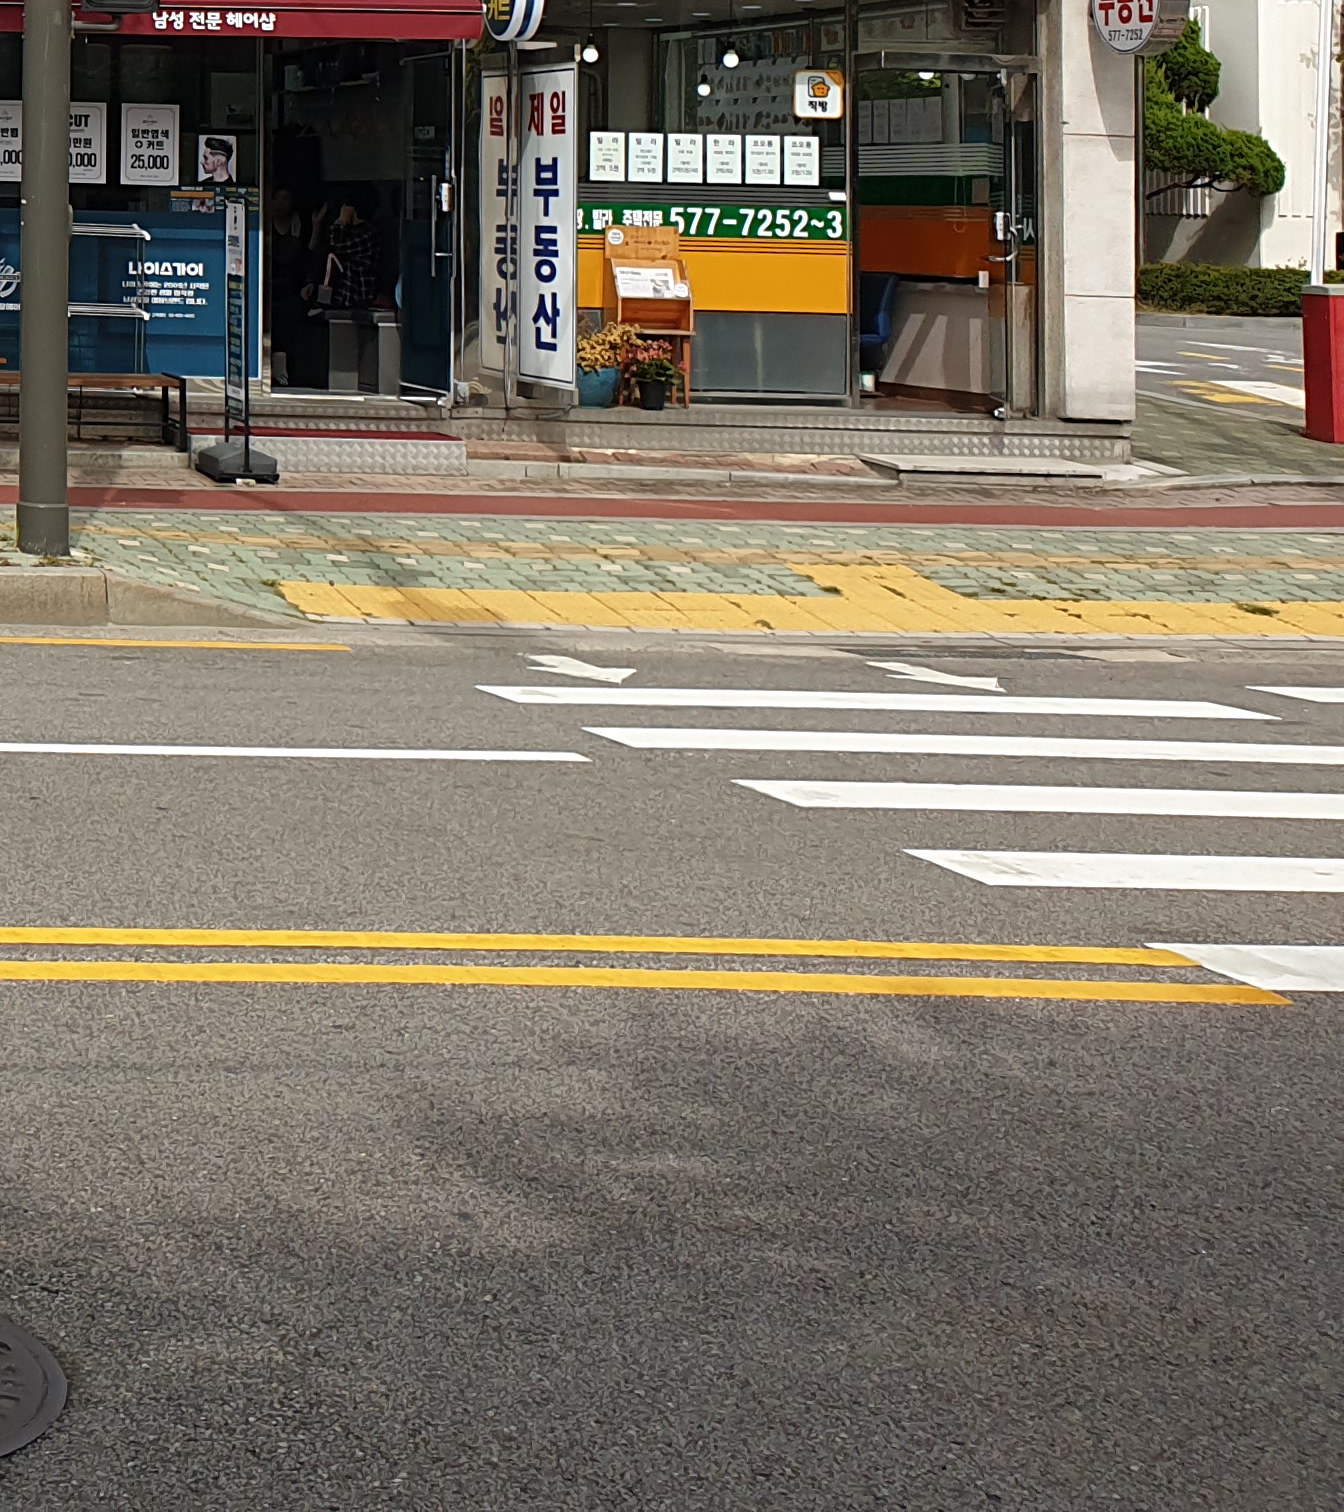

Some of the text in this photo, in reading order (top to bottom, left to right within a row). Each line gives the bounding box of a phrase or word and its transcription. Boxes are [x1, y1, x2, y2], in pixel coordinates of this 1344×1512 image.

[153, 10, 184, 30] 남성
[189, 11, 223, 31] 전문
[1108, 28, 1144, 42] 577-7252
[808, 100, 828, 113] 직방
[130, 154, 170, 171] 25,000
[527, 90, 567, 353] 제일 부동산
[669, 206, 844, 240] 577-7252~3
